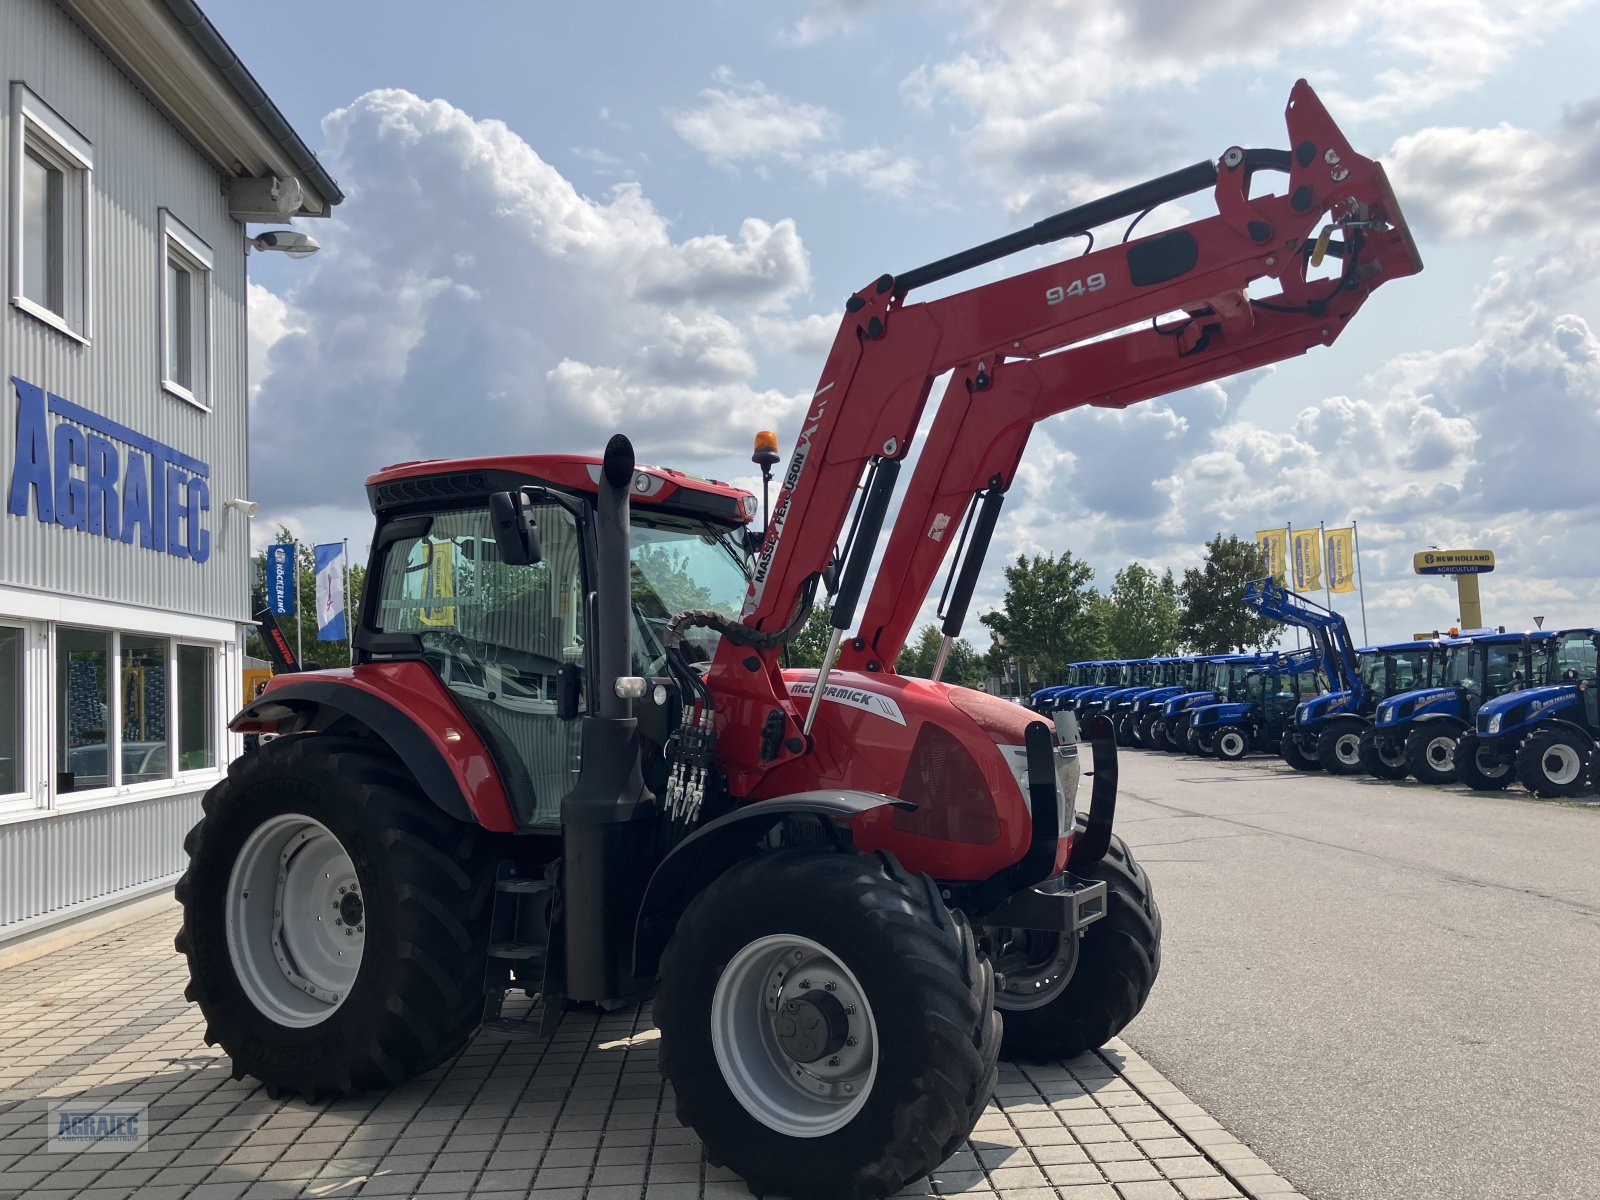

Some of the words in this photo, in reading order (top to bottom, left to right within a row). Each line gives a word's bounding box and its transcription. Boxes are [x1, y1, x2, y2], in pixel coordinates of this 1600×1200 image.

[1046, 272, 1106, 305] 949
[7, 375, 210, 564] AGRATEC
[276, 563, 286, 614] KÖCKERLING
